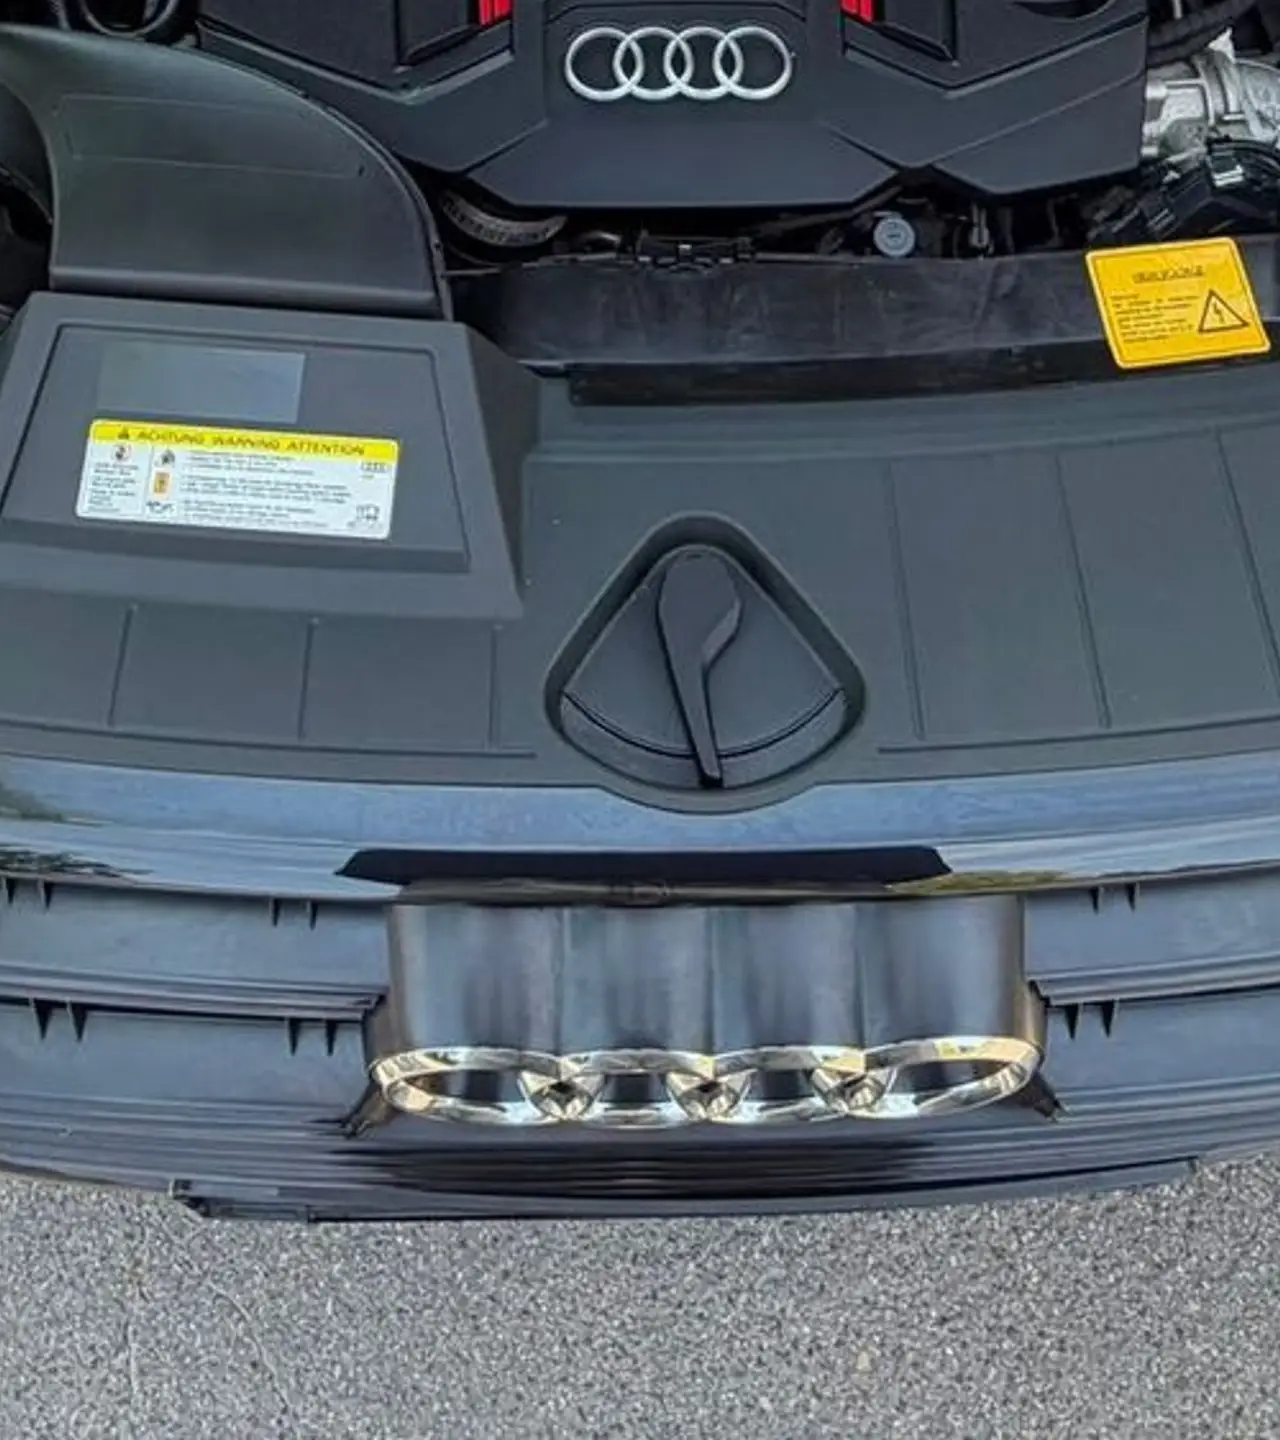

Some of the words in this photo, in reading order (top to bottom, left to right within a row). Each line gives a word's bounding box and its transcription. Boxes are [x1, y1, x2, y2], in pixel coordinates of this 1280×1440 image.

[139, 428, 204, 446] ACHTUNG
[212, 435, 280, 452] WARNING
[287, 440, 365, 457] ATTENTION
